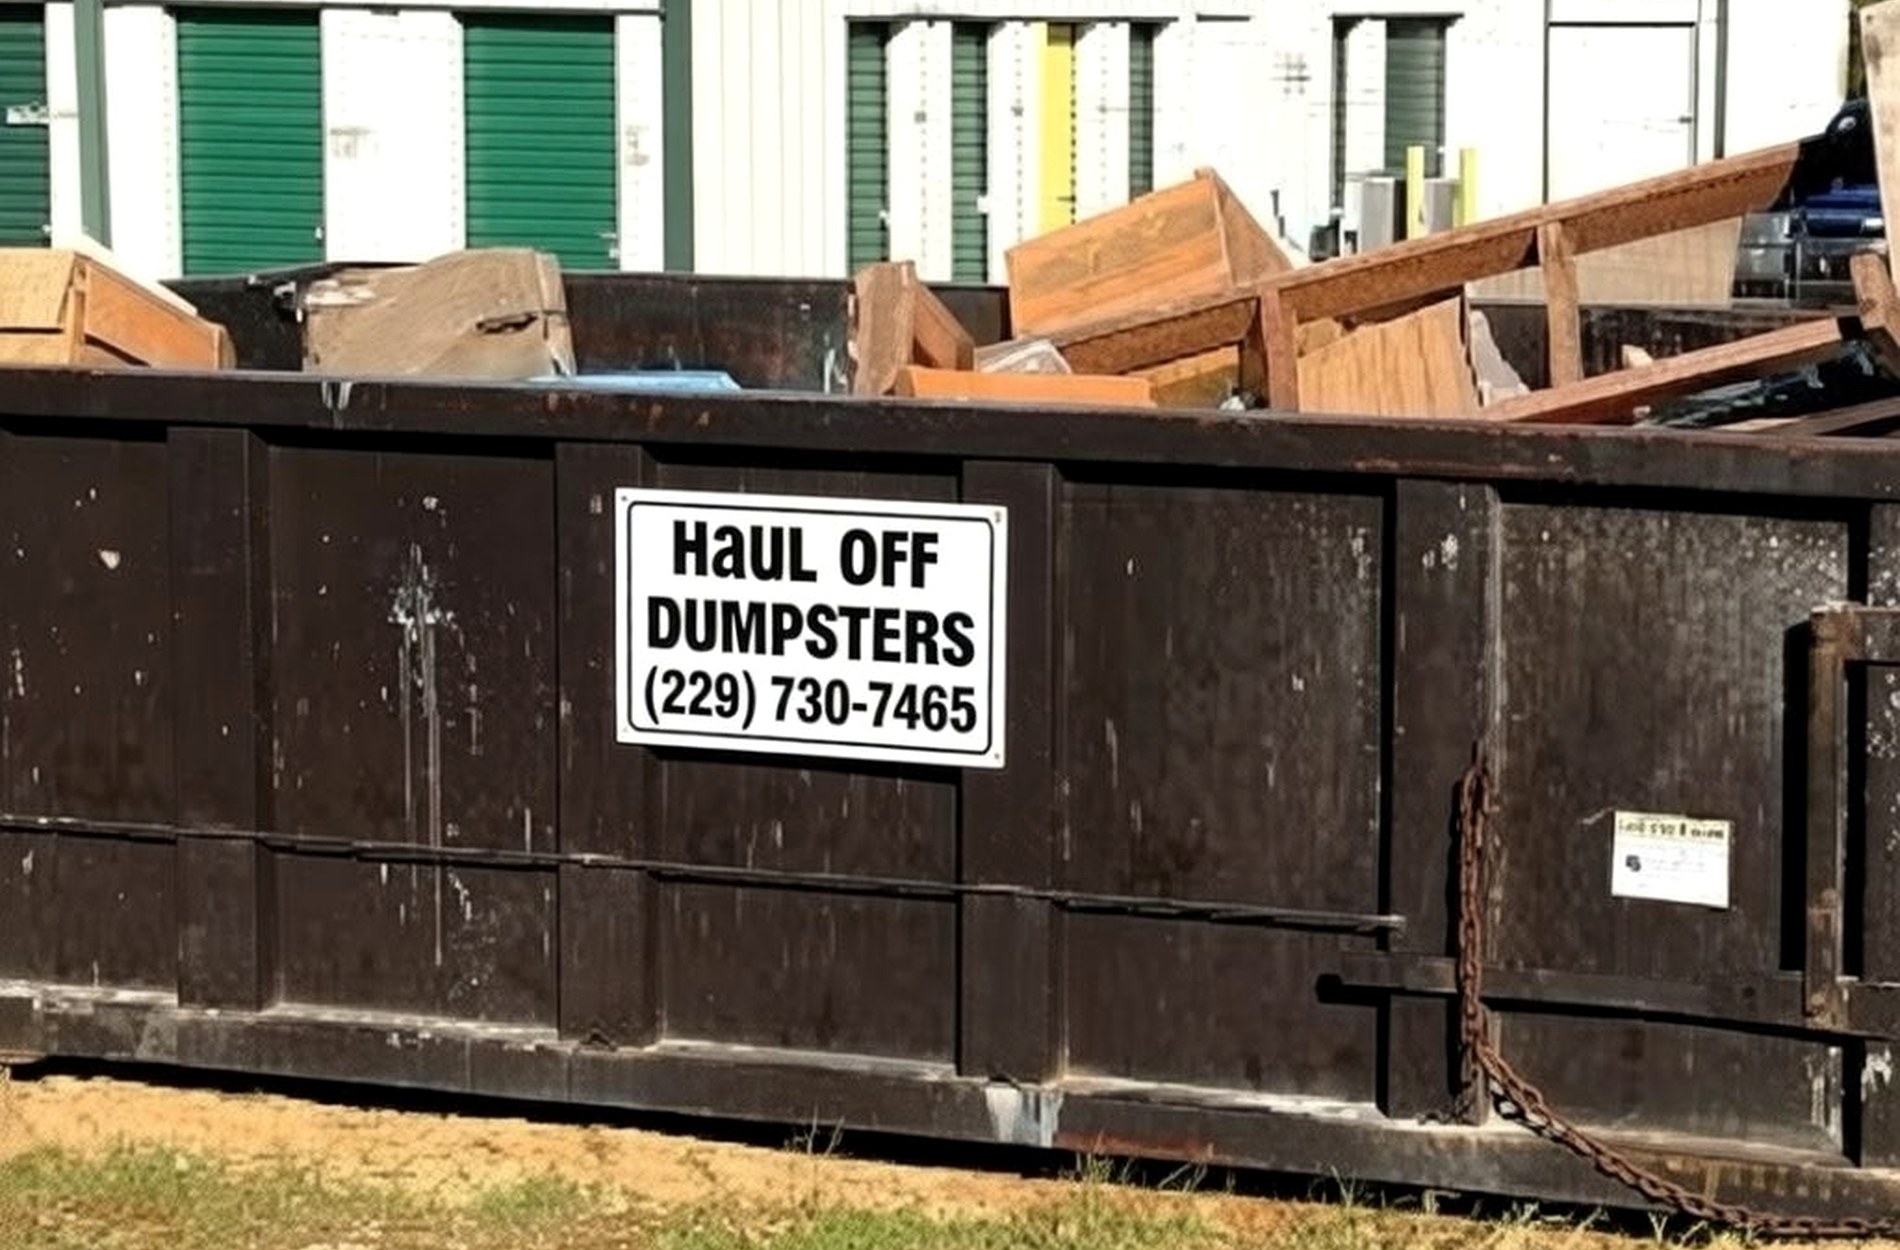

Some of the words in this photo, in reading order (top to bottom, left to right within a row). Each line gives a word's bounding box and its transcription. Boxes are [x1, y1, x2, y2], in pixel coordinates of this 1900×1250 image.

[840, 528, 939, 589] OFF
[647, 596, 975, 667] DUMPSTERS
[645, 665, 756, 730] (229)
[771, 675, 977, 733] 730-7465
